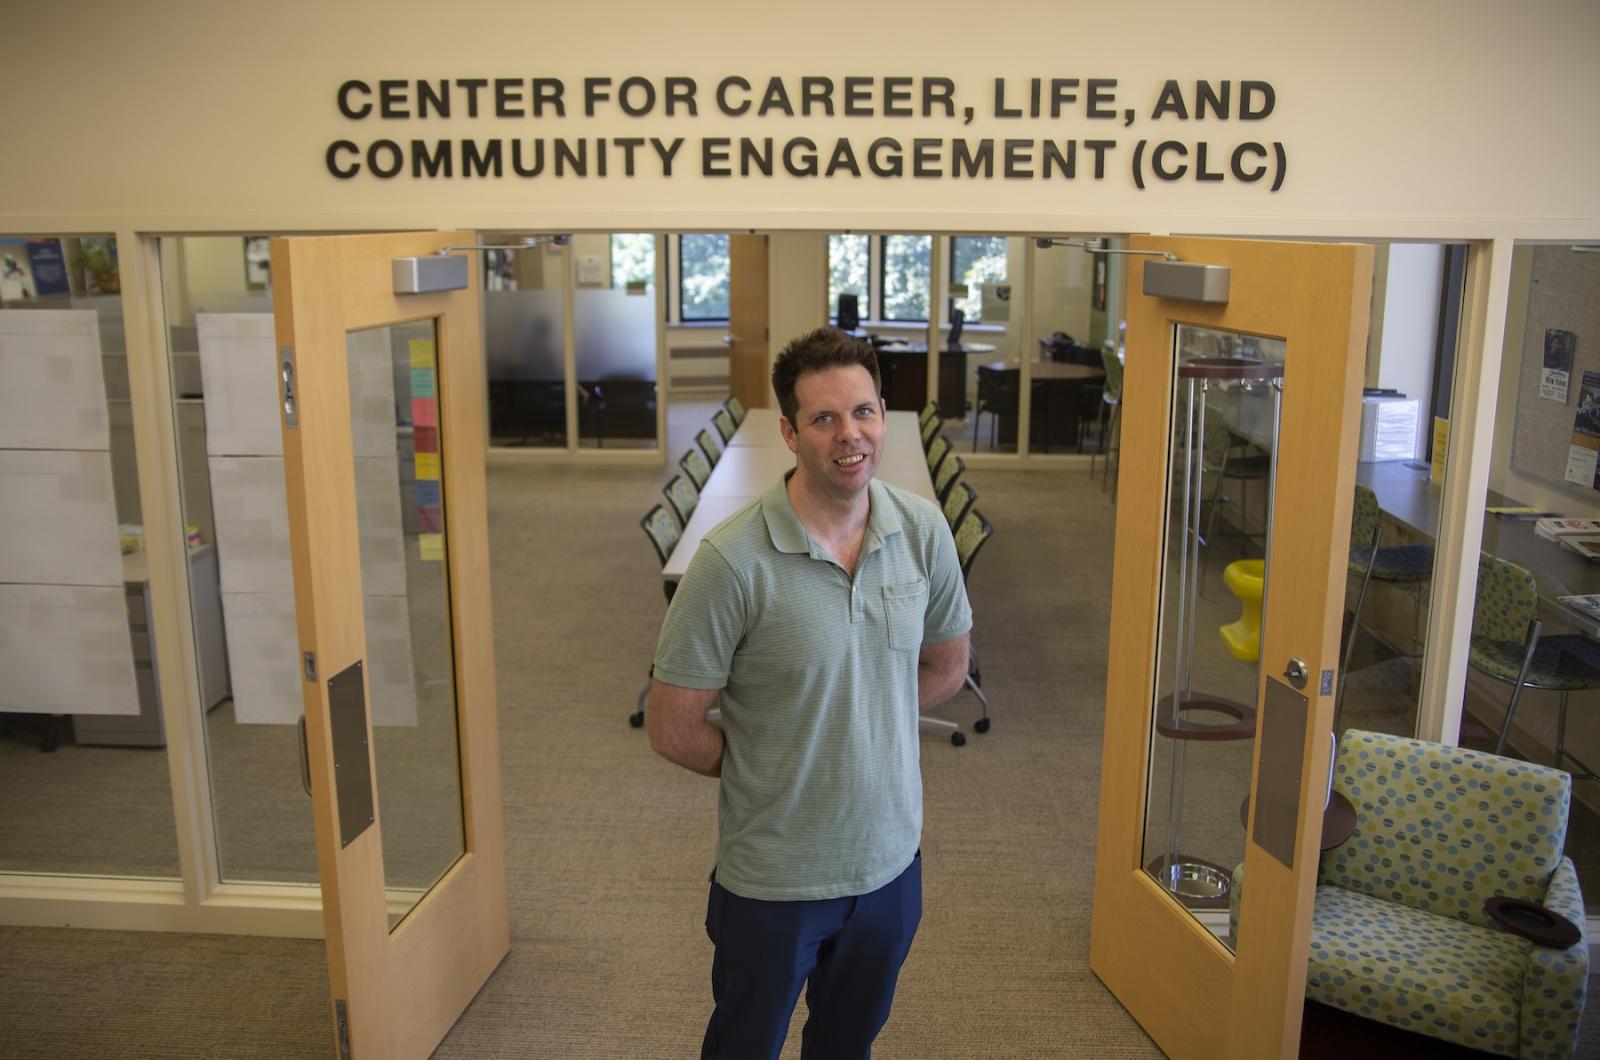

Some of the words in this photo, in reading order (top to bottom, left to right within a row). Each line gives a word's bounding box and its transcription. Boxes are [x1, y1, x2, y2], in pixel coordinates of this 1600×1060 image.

[336, 77, 566, 120] CENTER
[584, 76, 698, 118] FOR
[716, 76, 974, 125] CAREER,
[994, 78, 1135, 127] LIFE,
[1151, 80, 1276, 121] AND
[325, 137, 685, 180] COMMUNITY
[702, 137, 1117, 180] ENGAGEMENT
[1132, 139, 1288, 192] (CLC)
